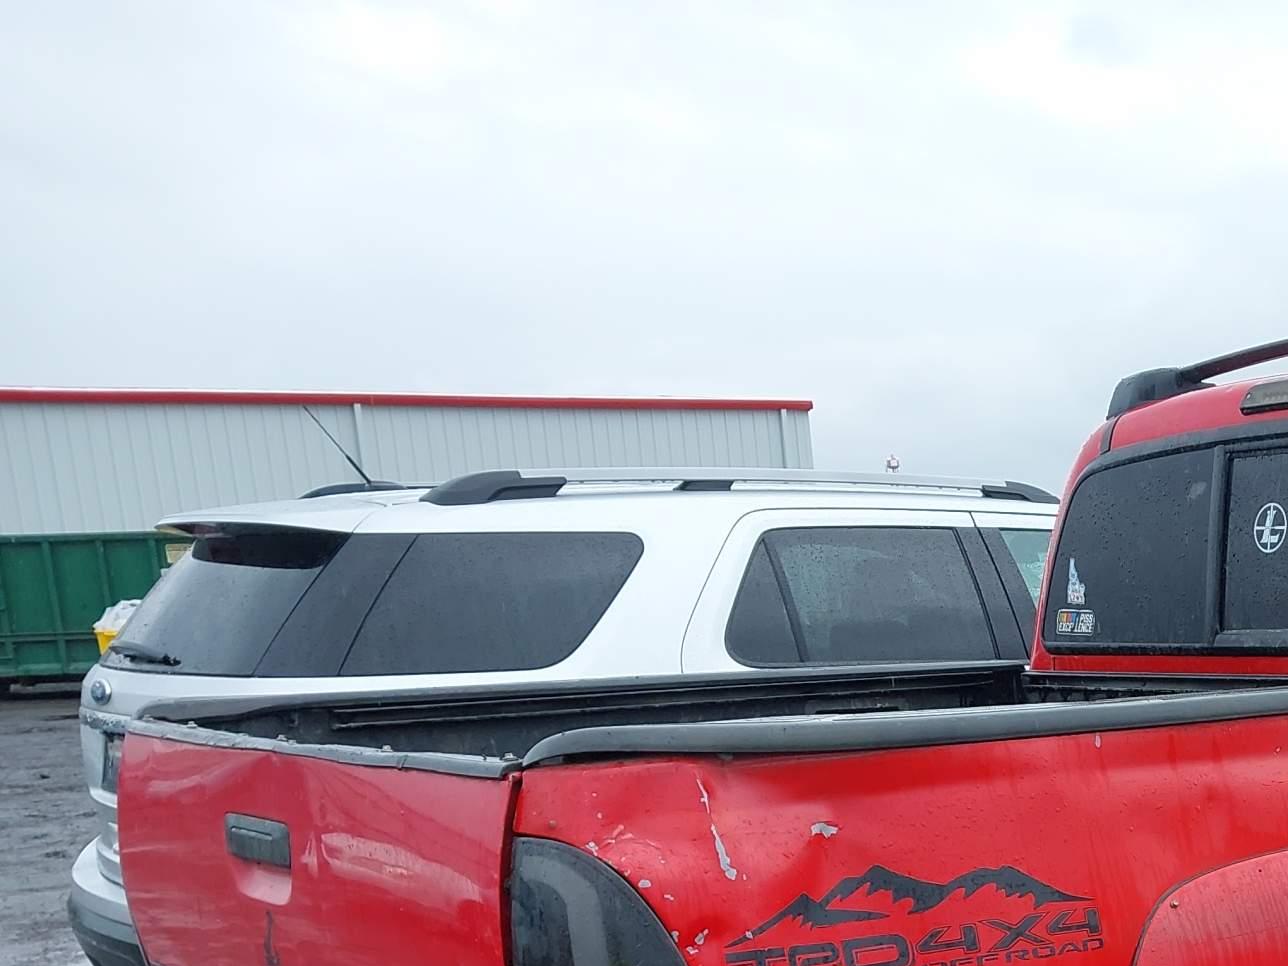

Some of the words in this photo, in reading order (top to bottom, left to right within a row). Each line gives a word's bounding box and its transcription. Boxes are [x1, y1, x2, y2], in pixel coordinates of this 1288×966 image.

[1079, 613, 1094, 623] PISS
[915, 906, 1104, 955] 4X4
[1004, 937, 1104, 962] ROAD
